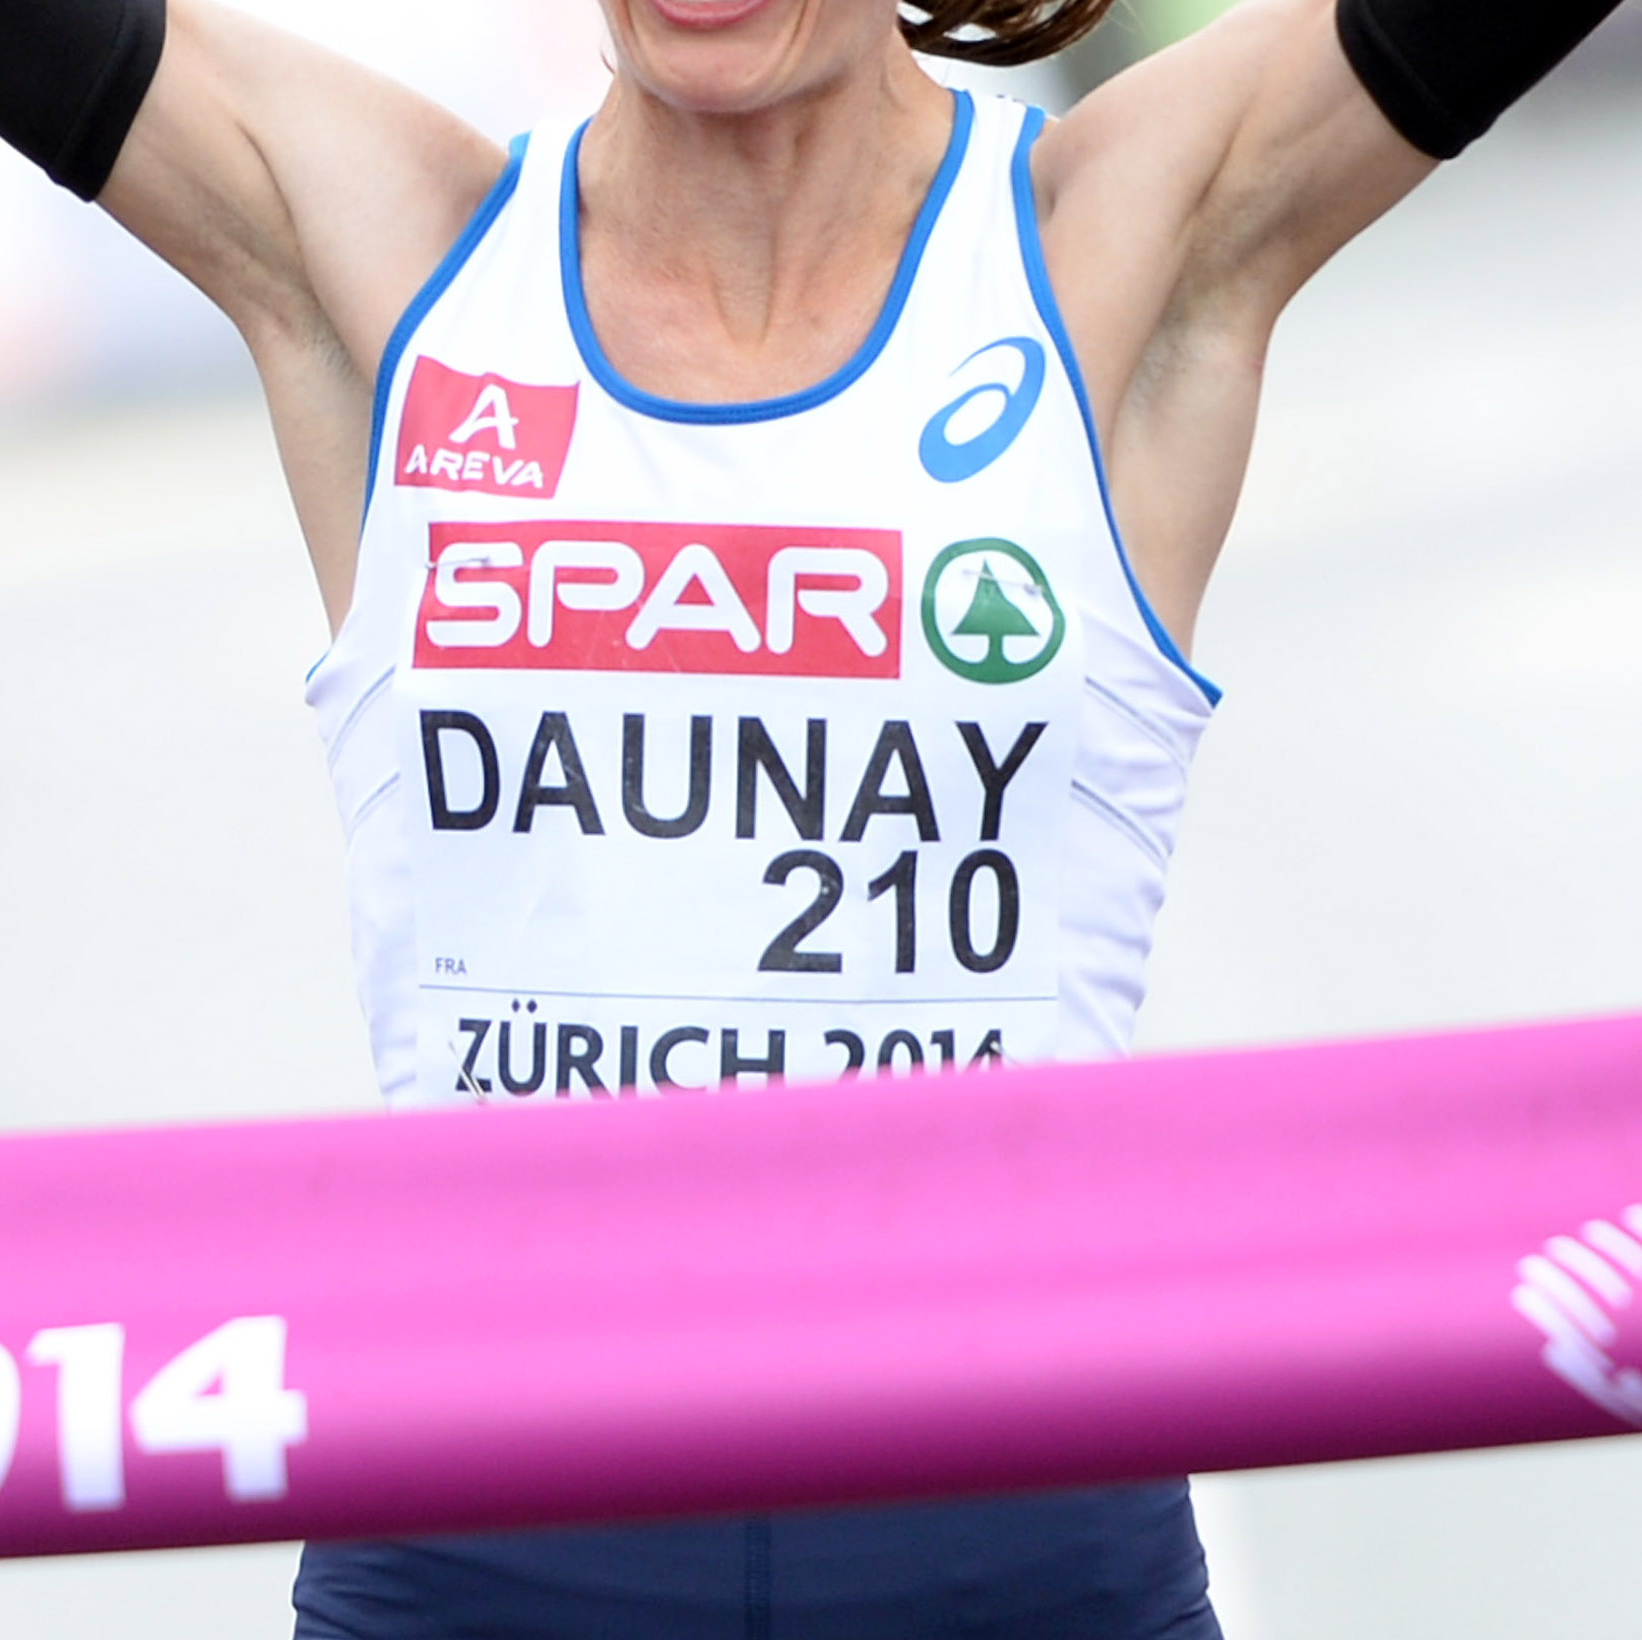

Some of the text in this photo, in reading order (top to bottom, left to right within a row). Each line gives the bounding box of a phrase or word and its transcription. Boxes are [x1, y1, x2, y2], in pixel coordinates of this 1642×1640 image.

[404, 443, 544, 489] AREVA
[426, 540, 889, 658] SPAR
[418, 709, 1049, 844] DAUNAY
[434, 956, 468, 975] FRA
[757, 849, 1021, 975] 210
[455, 997, 787, 1098] ZÜRICH
